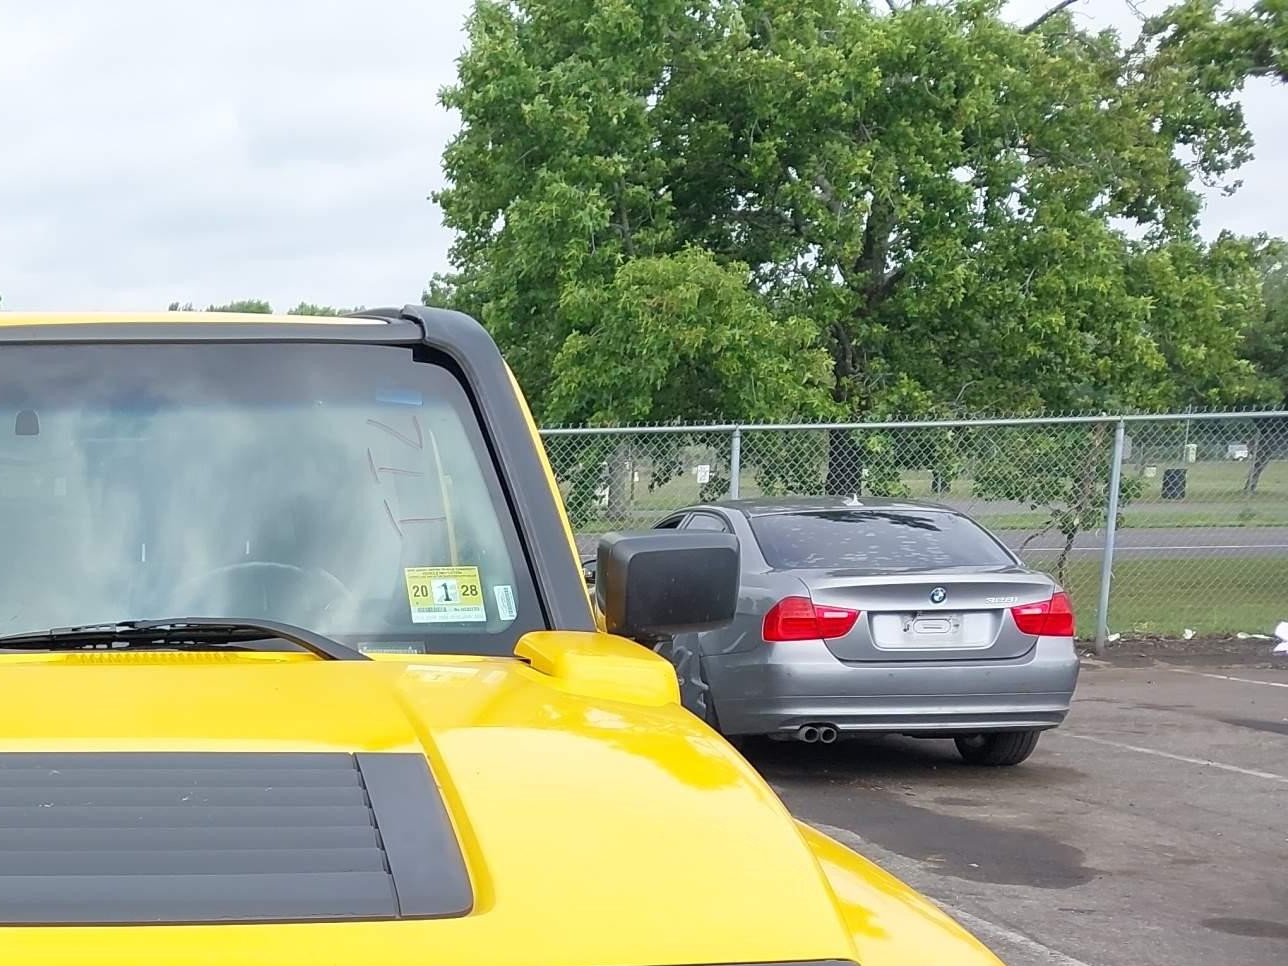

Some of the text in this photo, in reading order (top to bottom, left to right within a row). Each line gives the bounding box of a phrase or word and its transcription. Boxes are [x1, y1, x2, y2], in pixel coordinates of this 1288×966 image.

[412, 582, 478, 602] 20 1 28
